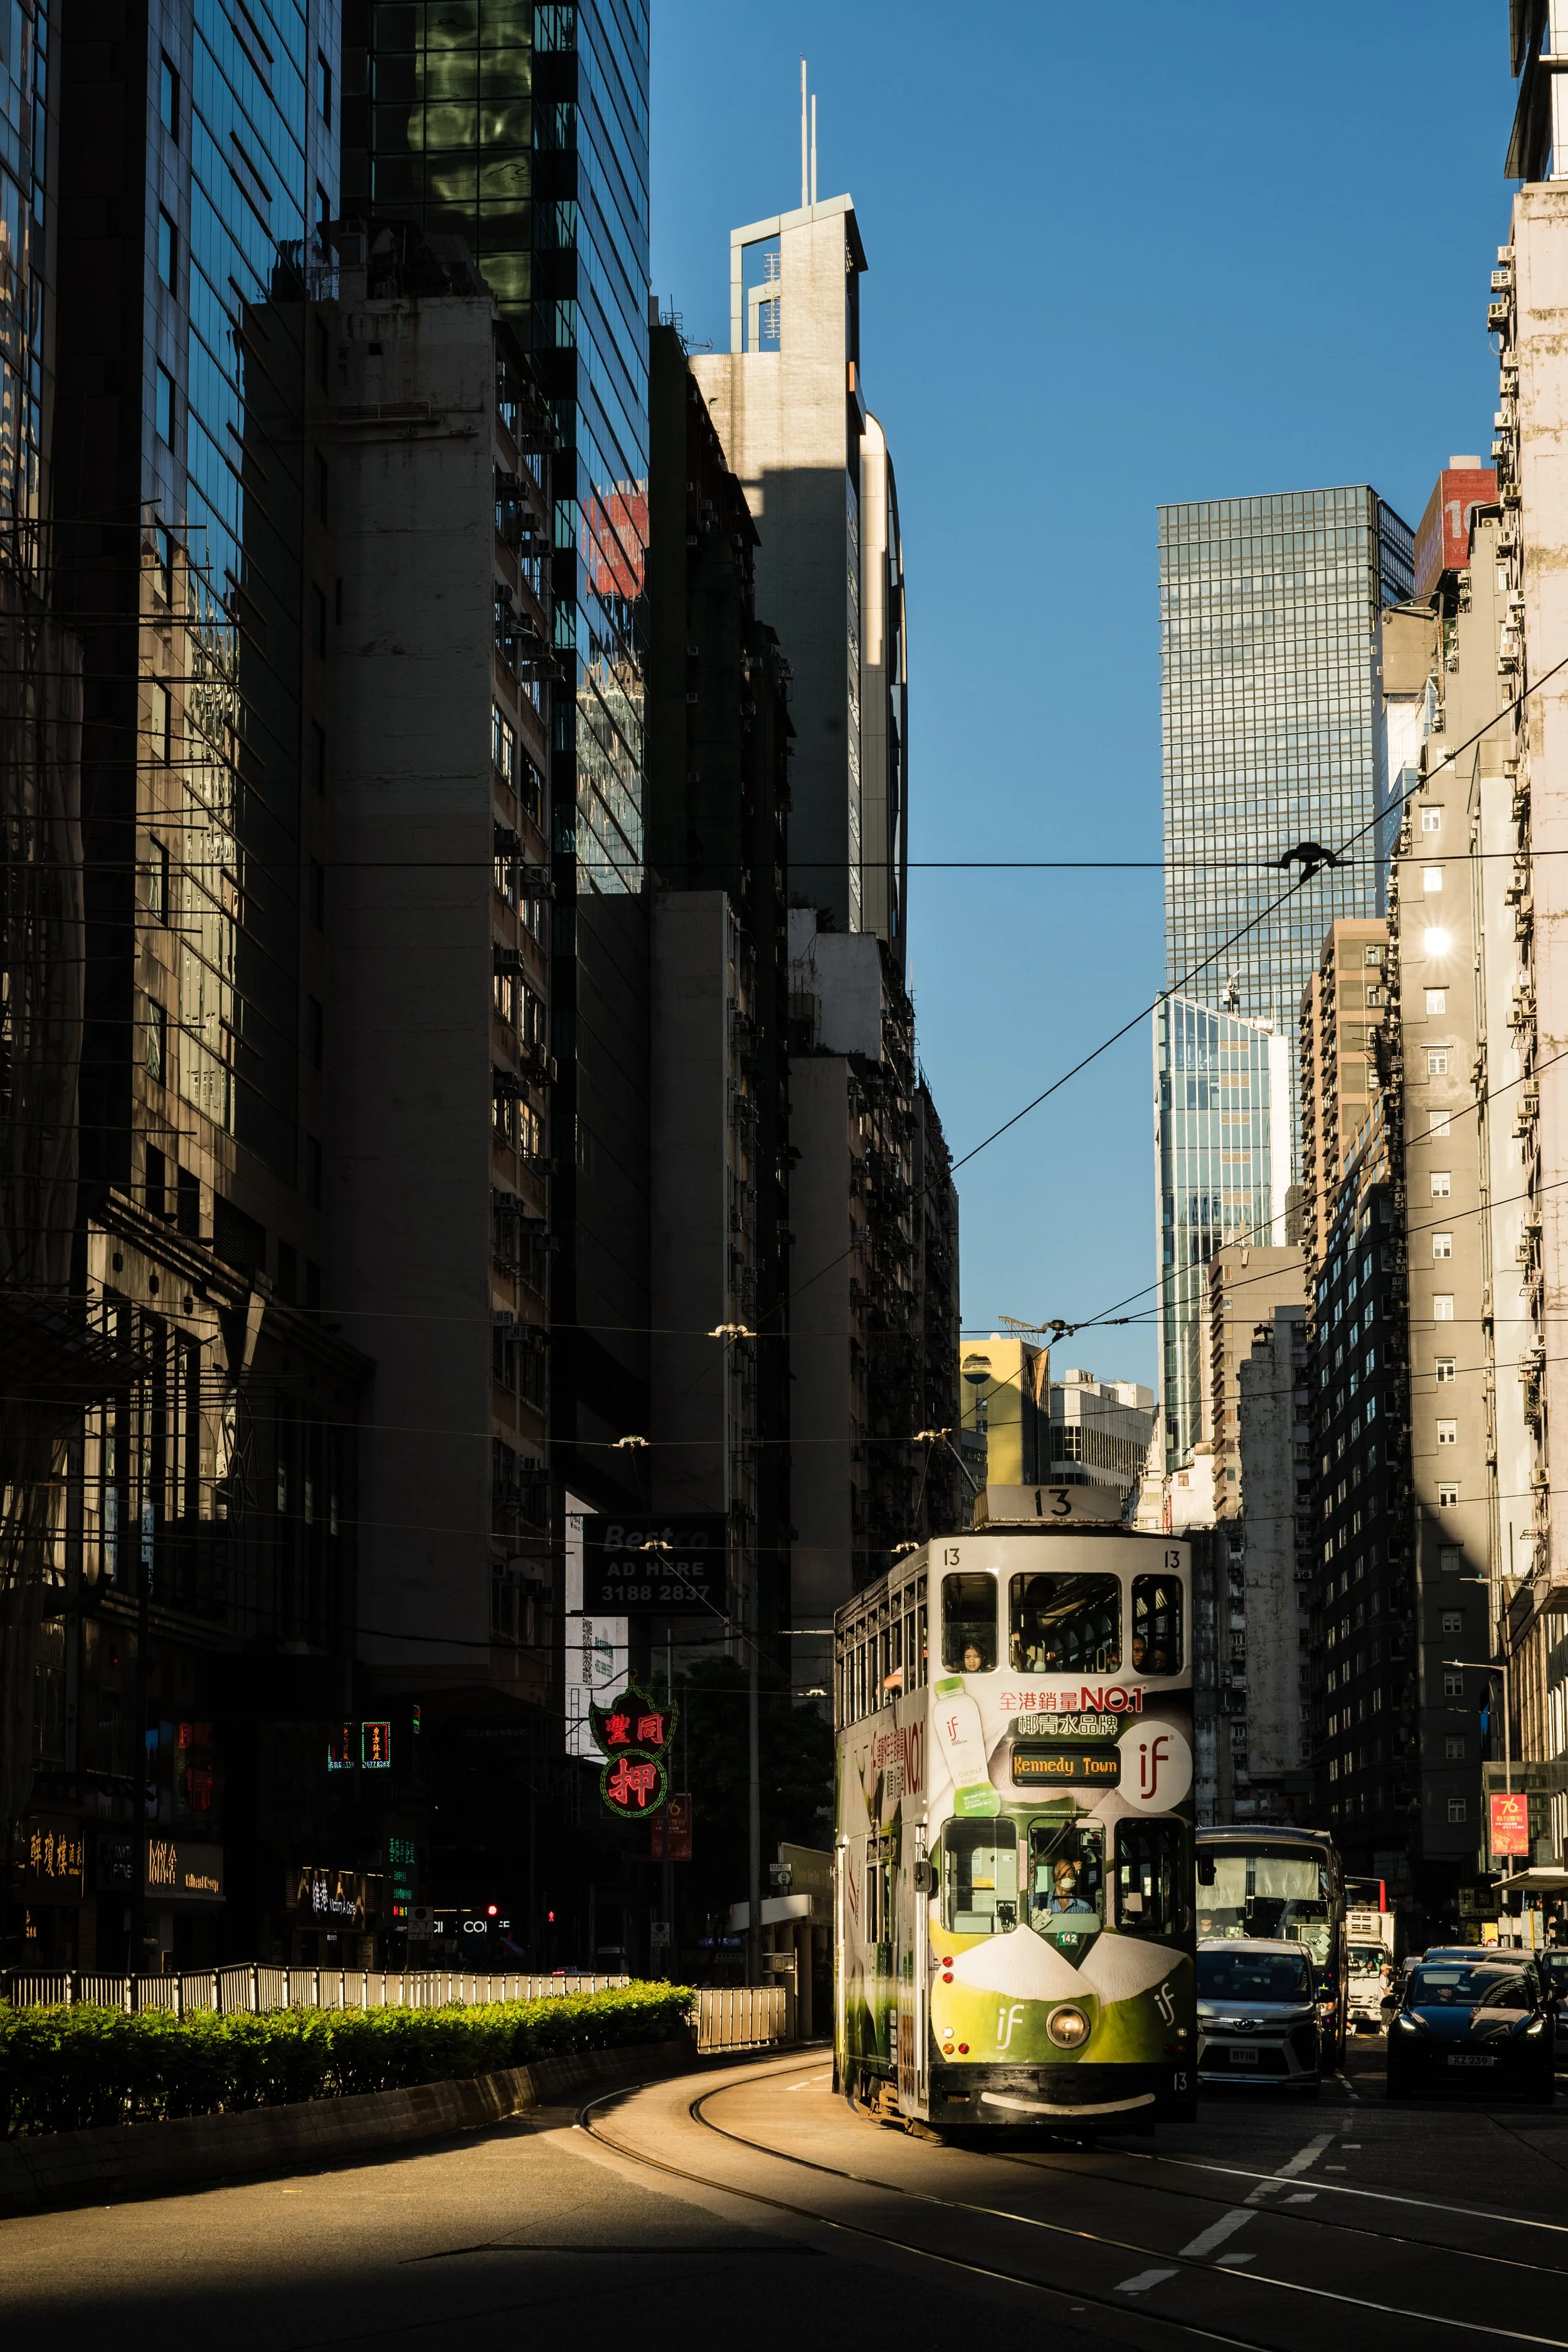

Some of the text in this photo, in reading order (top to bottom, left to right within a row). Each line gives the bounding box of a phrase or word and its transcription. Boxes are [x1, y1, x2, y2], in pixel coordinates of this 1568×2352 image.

[1036, 1489, 1072, 1517] 13
[603, 1525, 710, 1553] Bestco
[944, 1547, 960, 1565] 13
[1165, 1550, 1180, 1568] 13
[606, 1562, 704, 1576] AD HERE
[601, 1586, 710, 1601] 3188 2837
[999, 1692, 1078, 1711] 全港銷量
[946, 1716, 958, 1740] if
[1019, 1715, 1118, 1735] 椰青水品牌
[959, 1767, 983, 1778] Coconut
[1014, 1757, 1117, 1776] Kennedy Town
[1140, 1736, 1168, 1799] if
[609, 1759, 656, 1806] 押
[960, 1776, 978, 1786] Water
[1500, 1798, 1519, 1814] 76
[1463, 1894, 1471, 1904] P
[1061, 1933, 1078, 1943] 142
[1154, 1983, 1174, 2026] if
[996, 2004, 1025, 2050] if
[1173, 2072, 1187, 2090] 13
